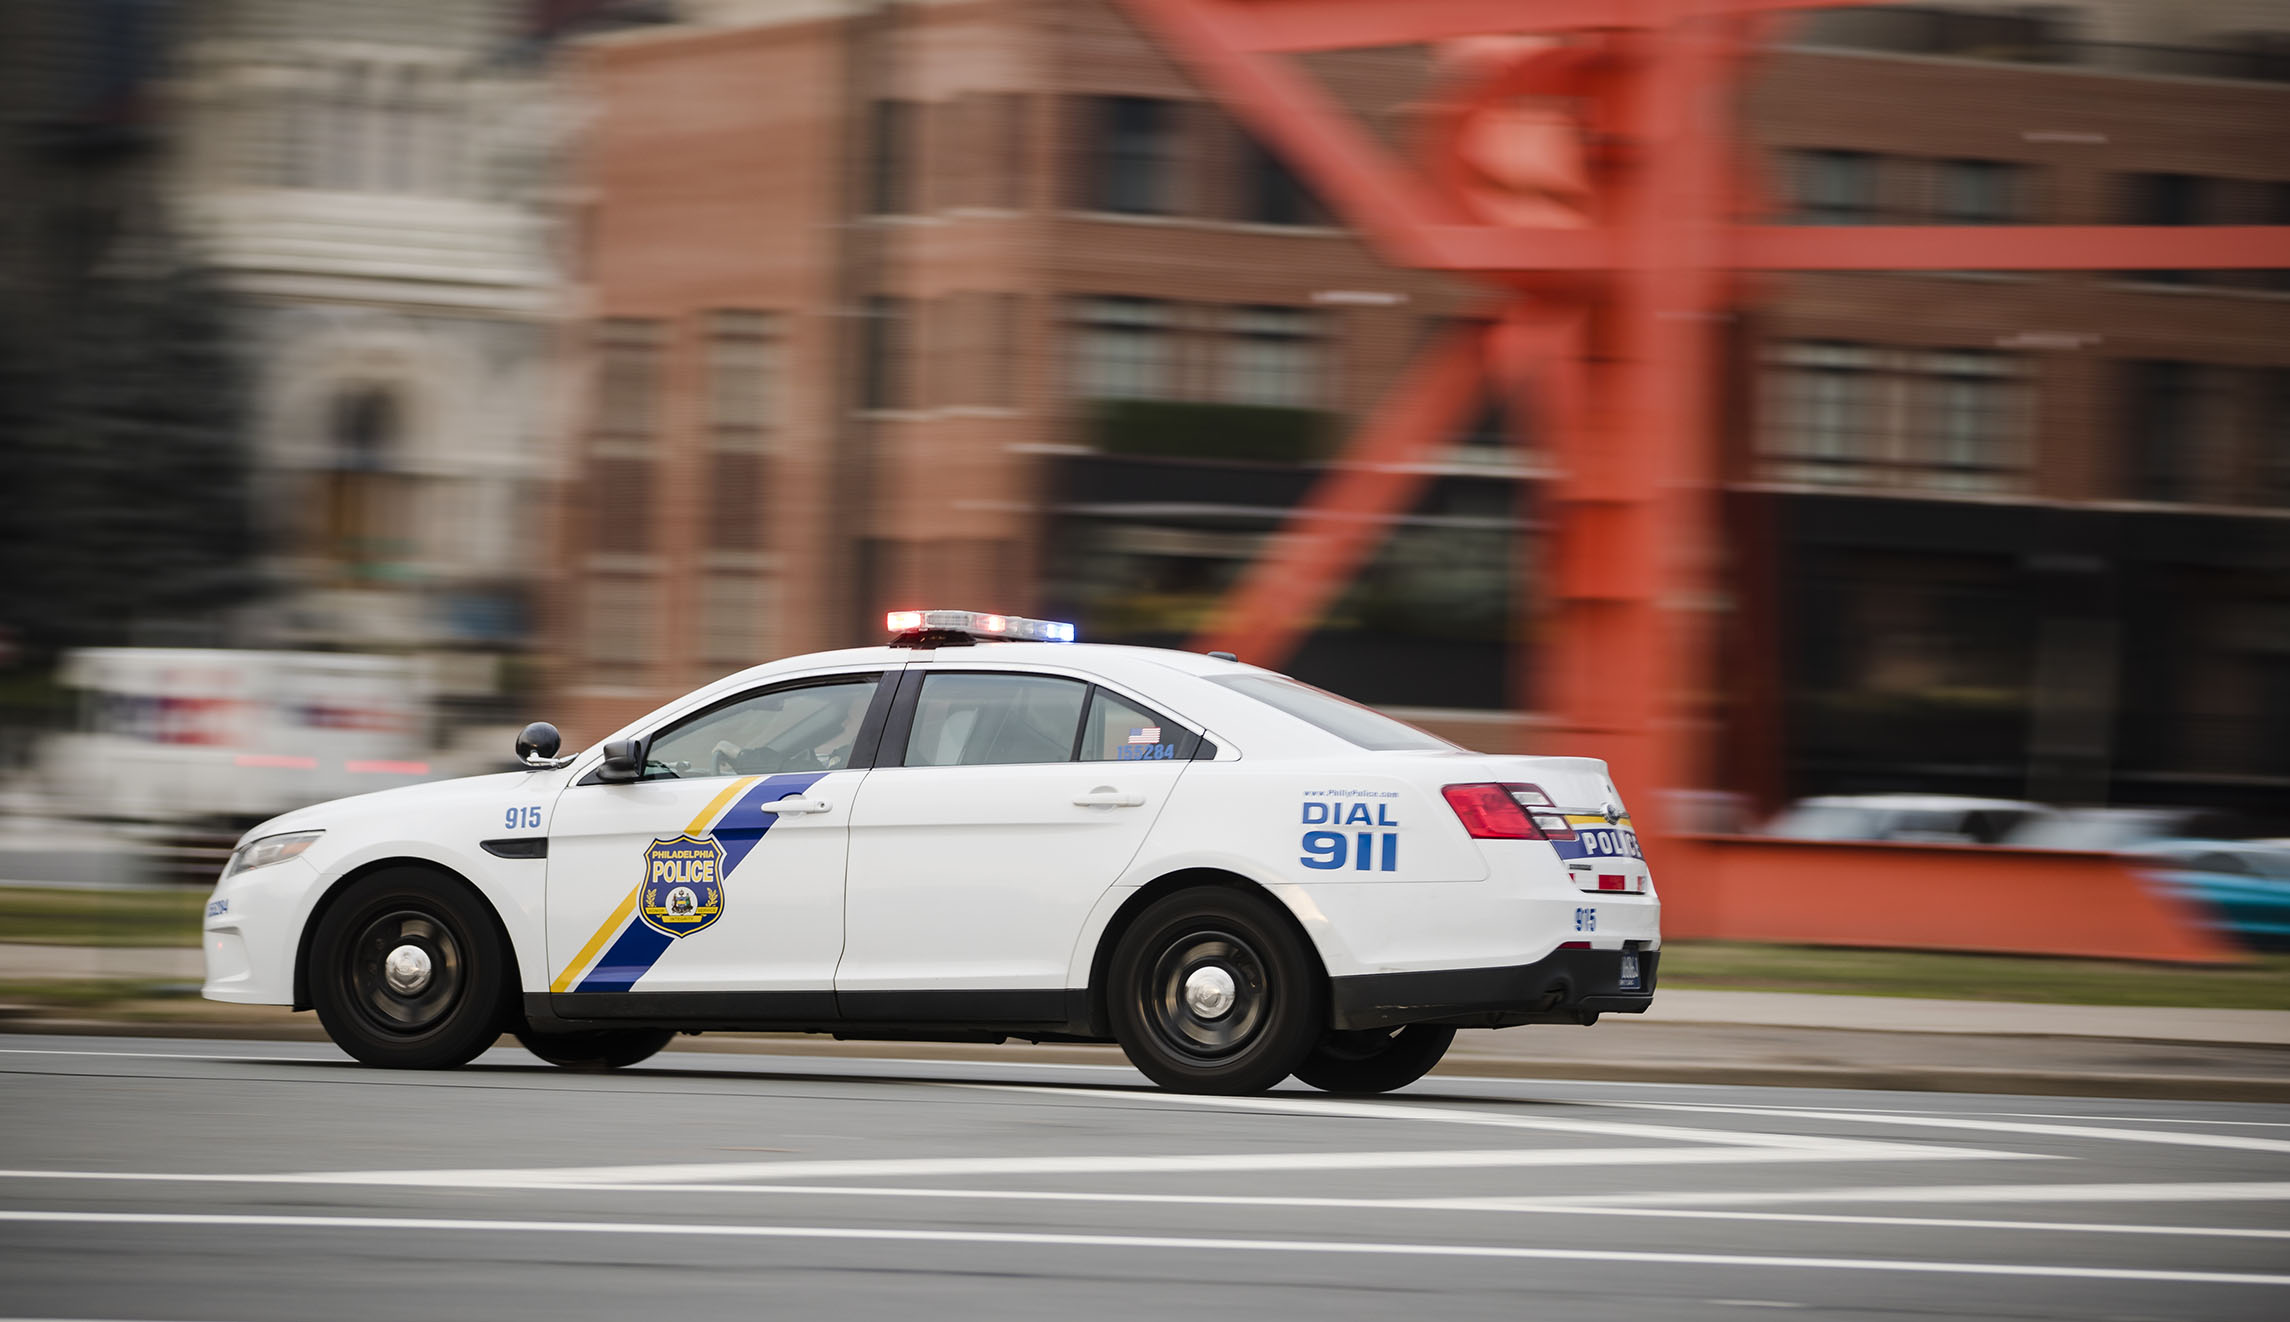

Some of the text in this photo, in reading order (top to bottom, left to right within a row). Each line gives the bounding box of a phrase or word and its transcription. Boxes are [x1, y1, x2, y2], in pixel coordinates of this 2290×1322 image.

[1117, 744, 1174, 760] 155284
[505, 806, 542, 829] 915
[1302, 802, 1398, 826] DIAL
[652, 850, 714, 859] PHILADELPHIA
[1300, 830, 1397, 872] 911
[1581, 831, 1643, 858] POLICE
[652, 860, 714, 883] POLICE
[1575, 907, 1596, 932] 915
